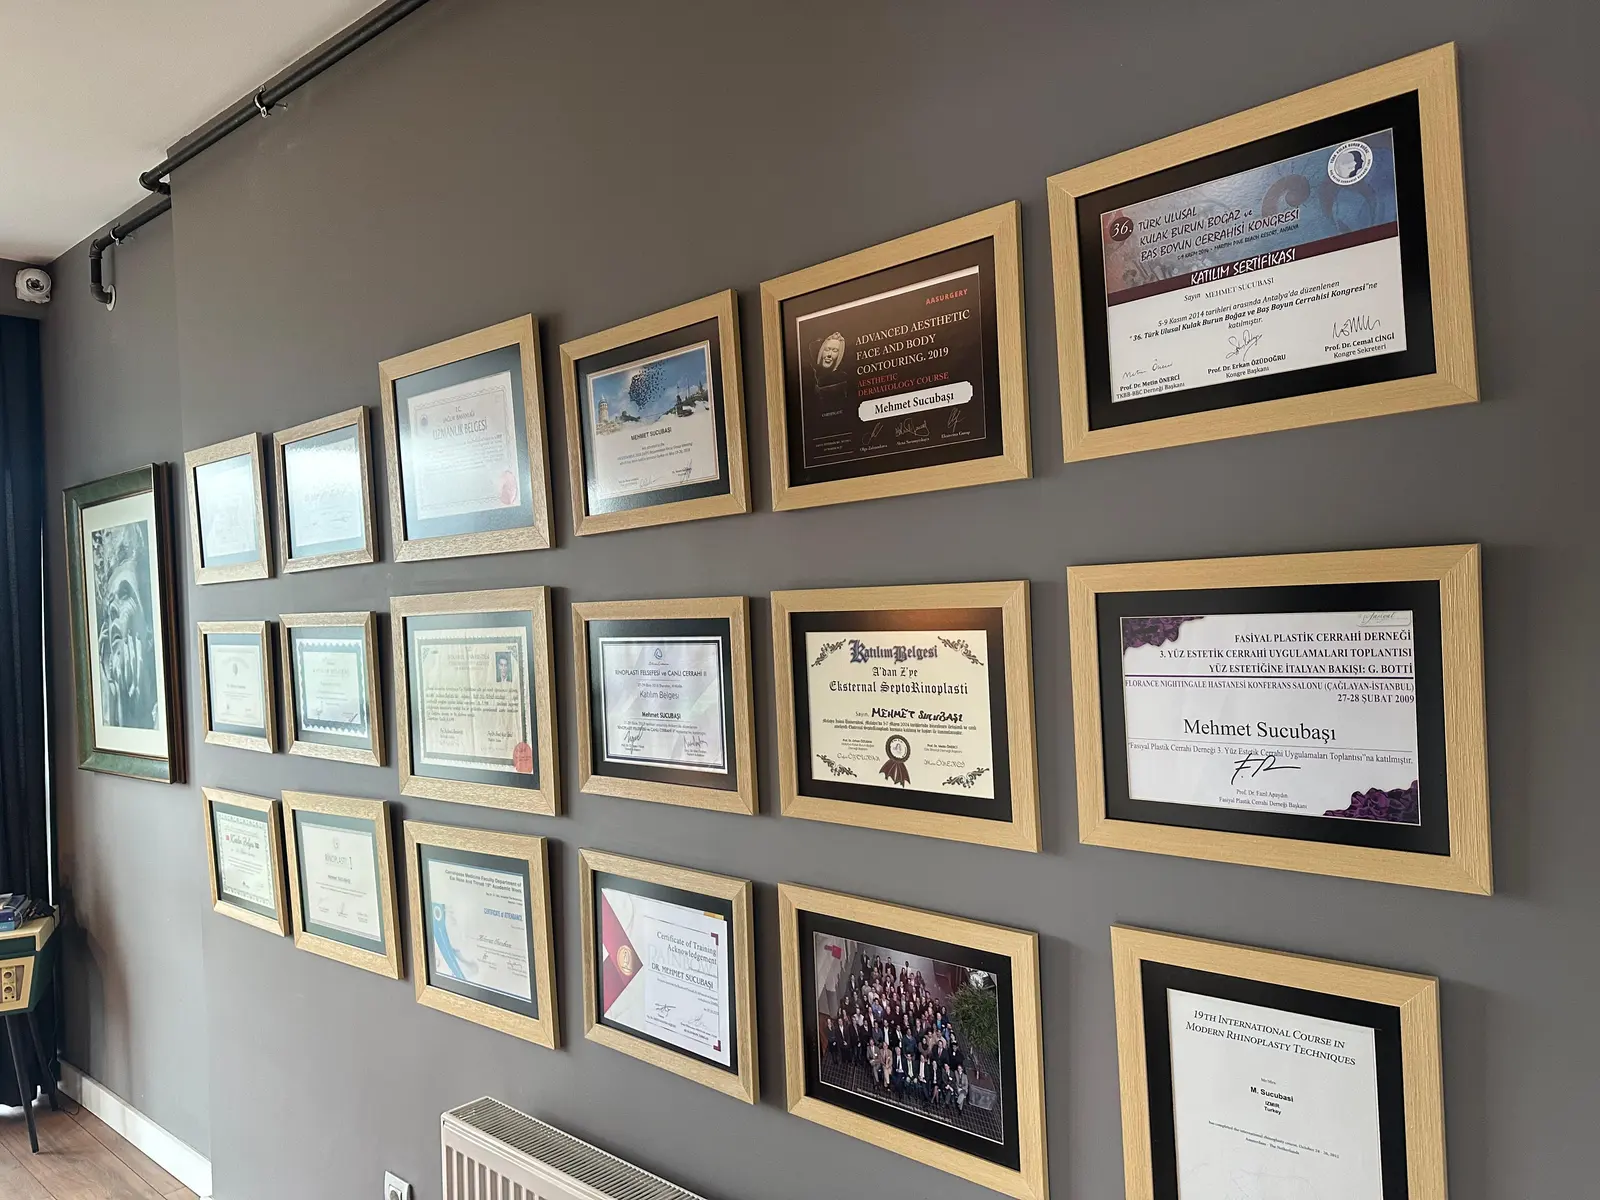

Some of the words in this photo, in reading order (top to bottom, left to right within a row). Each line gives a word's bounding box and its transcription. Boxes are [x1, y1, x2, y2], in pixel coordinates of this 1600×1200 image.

[1138, 215, 1161, 231] TÜRK
[1164, 206, 1197, 224] ULUSAL
[1111, 219, 1132, 237] 36.
[1140, 229, 1169, 246] KULAK
[1171, 219, 1204, 238] BURUN
[1160, 238, 1192, 256] BOYUN
[1195, 222, 1245, 247] CERRAHİSİ
[1248, 207, 1299, 233] KONGRESİ
[1191, 264, 1230, 285] KATILIM
[1233, 246, 1296, 275] SERTİFİKASI
[926, 288, 968, 306] AASURGERY
[1184, 292, 1201, 303] Sayın
[1205, 286, 1236, 299] MEHMET
[1237, 276, 1274, 292] SUCUBAŞI
[1181, 320, 1200, 330] Kulak
[1256, 305, 1270, 315] Baş
[1271, 299, 1293, 312] Boyun
[1295, 291, 1330, 305] Cerrahisi
[1188, 310, 1204, 319] 2014
[856, 324, 908, 347] ADVANCED
[911, 308, 970, 333] AESTHETIC
[856, 347, 880, 361] FACE
[882, 341, 904, 355] AND
[906, 333, 936, 350] BODY
[1352, 337, 1374, 347] Cemal
[1375, 332, 1394, 343] CİNGİ
[1334, 349, 1357, 359] Kongre
[1358, 343, 1387, 354] Sekreteri
[857, 351, 925, 376] CONTOURING.
[928, 346, 949, 360] 2019
[858, 372, 898, 388] AESTHETIC
[858, 378, 915, 398] DERMATOLOGY
[917, 371, 949, 385] COURSE
[874, 398, 911, 415] Mehmet
[913, 388, 954, 407] Sucubaşı
[1235, 633, 1272, 642] FASİYAL
[1273, 632, 1314, 642] PLASTİK
[1316, 631, 1361, 641] CERRAHİ
[1364, 630, 1411, 641] DERNEĞİ
[1160, 650, 1166, 658] 3.
[1168, 649, 1184, 658] YÜZ
[1187, 649, 1224, 658] ESTETİK
[1226, 648, 1267, 658] CERRAHİ
[1269, 649, 1348, 658] UYGULAMALARI
[1350, 648, 1412, 657] TOPLANTISI
[1209, 663, 1228, 673] YÜZ
[1230, 663, 1283, 673] ESTETİĞİNE
[1286, 663, 1325, 673] İTALYAN
[1328, 664, 1365, 675] BAKIŞI:
[1368, 664, 1378, 673] G.
[1381, 663, 1412, 673] BOTTİ
[829, 680, 876, 692] Eksternal
[1125, 679, 1159, 687] FLORANCE
[1160, 680, 1207, 688] NIGHTINGALE
[1208, 679, 1246, 689] HASTANESİ
[1247, 681, 1291, 689] KONFERANS
[1293, 681, 1323, 690] SALONU
[1337, 694, 1359, 702] 27-28
[1361, 694, 1393, 704] ŞUBAT
[1395, 695, 1415, 703] 2009
[1184, 718, 1251, 737] Mehmet
[1257, 721, 1336, 744] Sucubaşı
[657, 931, 684, 946] Certificate
[686, 939, 692, 948] of
[1250, 1086, 1258, 1094] M.
[1261, 1088, 1294, 1103] Sucubasi
